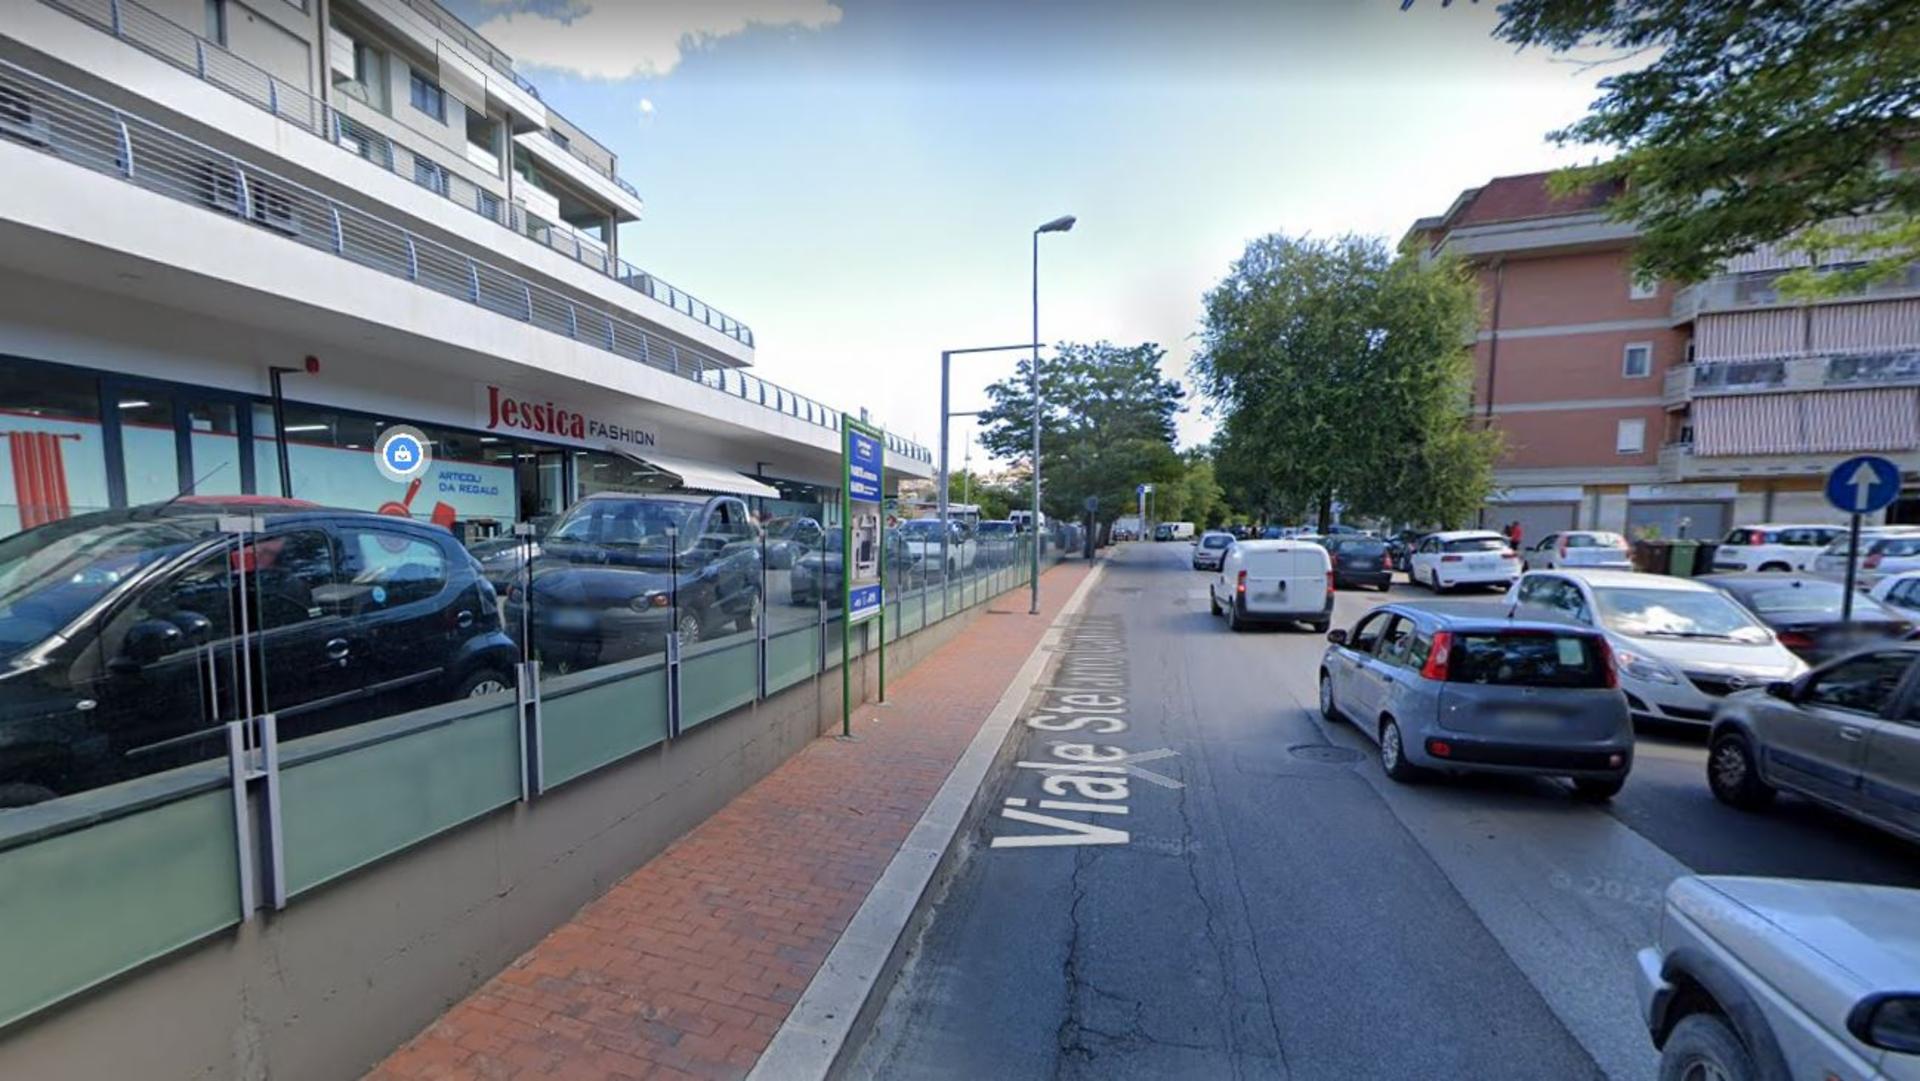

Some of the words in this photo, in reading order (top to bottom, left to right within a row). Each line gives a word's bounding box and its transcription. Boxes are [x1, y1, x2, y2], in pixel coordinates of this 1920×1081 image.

[486, 385, 585, 440] Jessica
[589, 419, 655, 447] FASHION
[438, 471, 482, 483] ARTICOLI
[439, 482, 455, 492] DA
[459, 484, 498, 495] REGALO
